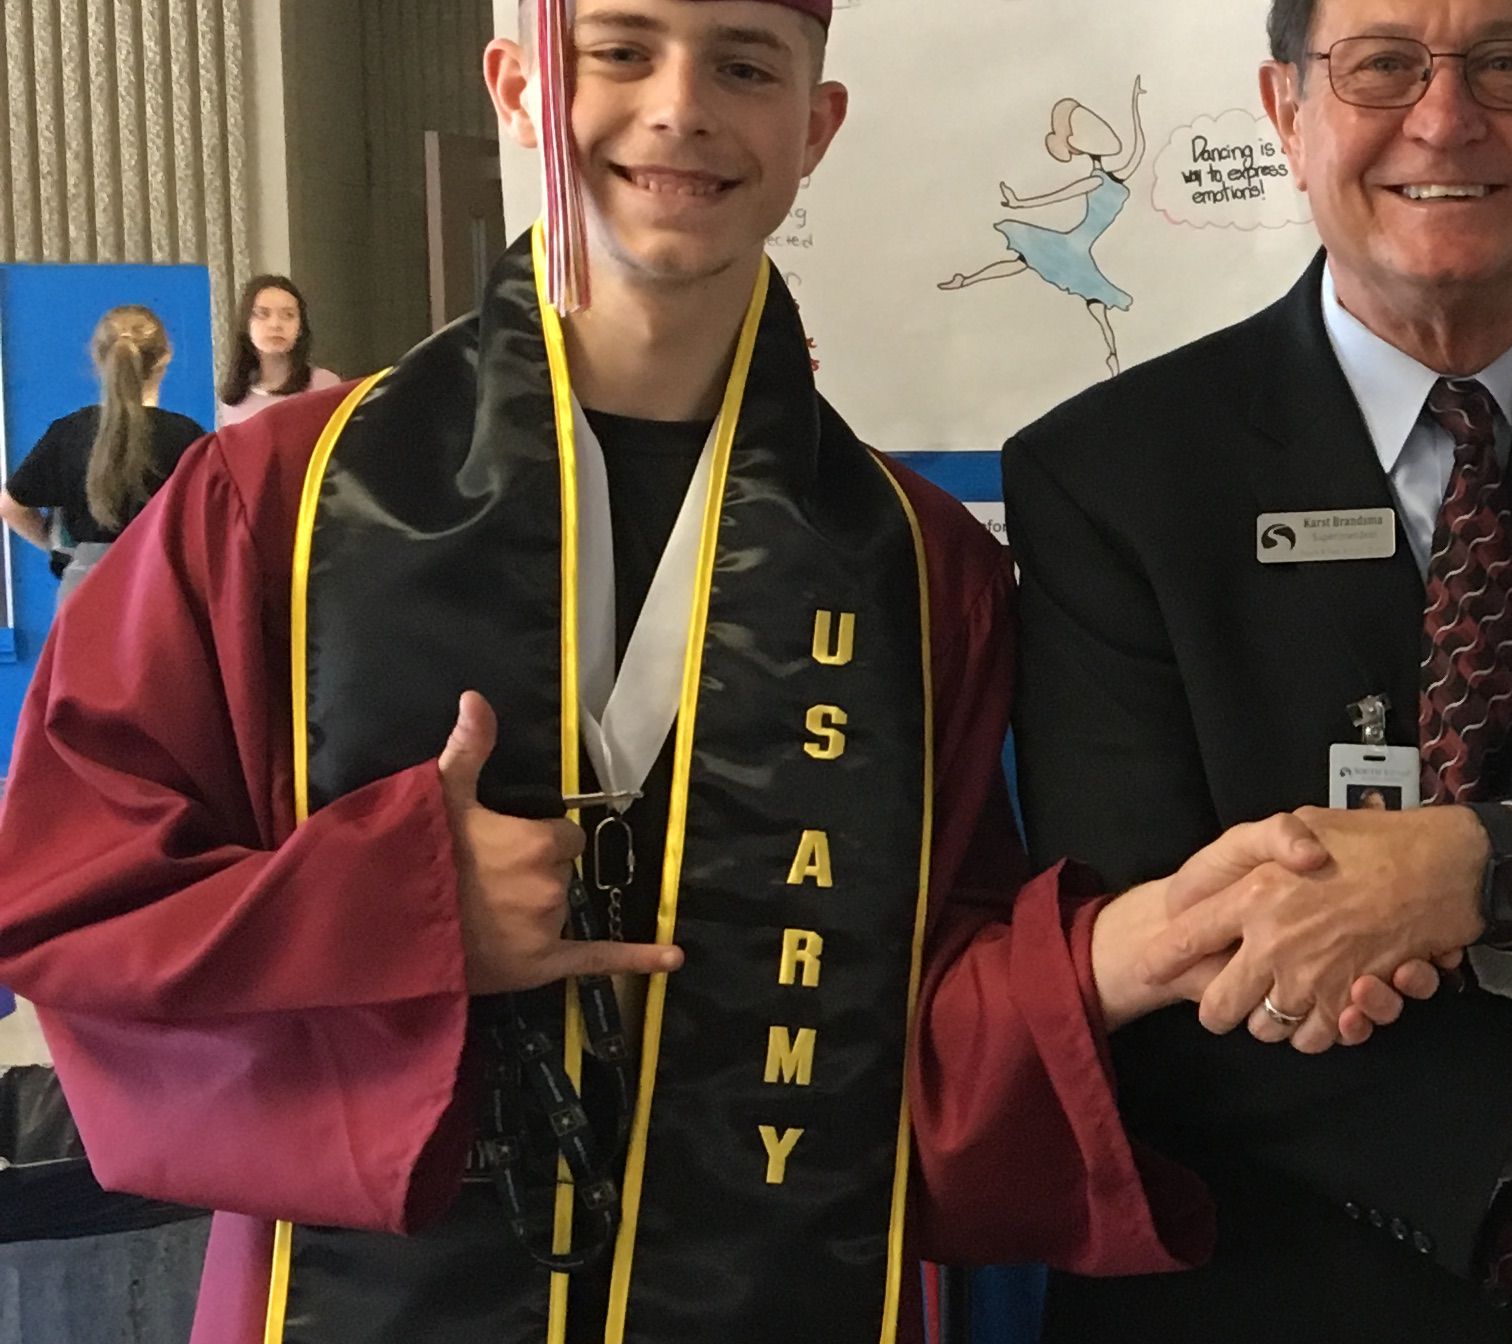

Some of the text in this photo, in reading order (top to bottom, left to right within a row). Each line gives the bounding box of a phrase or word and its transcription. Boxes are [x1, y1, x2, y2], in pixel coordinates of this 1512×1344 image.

[1191, 135, 1253, 170] Dancing
[1258, 138, 1275, 157] is
[1206, 163, 1222, 182] to
[1227, 164, 1288, 187] express
[1192, 178, 1266, 204] emotions!
[757, 829, 833, 1183] ARMY
